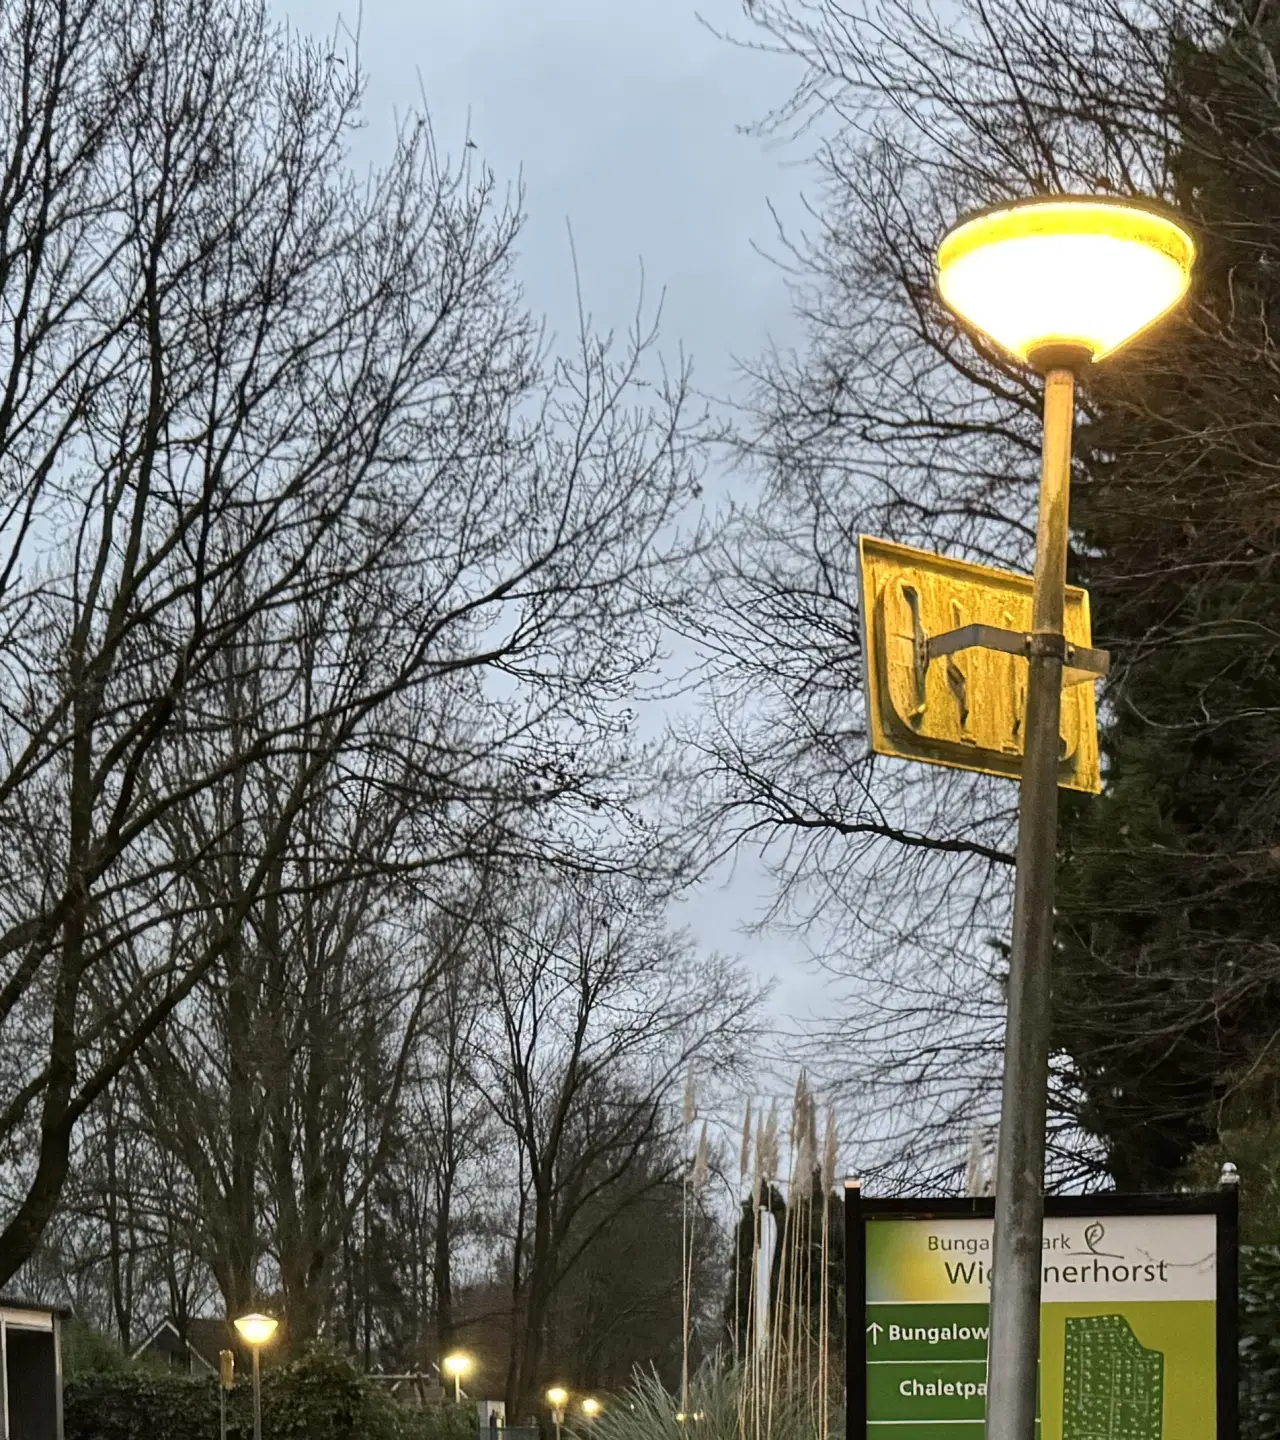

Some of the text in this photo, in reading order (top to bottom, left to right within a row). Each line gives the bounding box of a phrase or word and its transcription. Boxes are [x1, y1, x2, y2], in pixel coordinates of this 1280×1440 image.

[927, 1233, 1071, 1255] Bungaark
[944, 1259, 1168, 1290] Winerhorst
[899, 1379, 988, 1400] Chaletpa
